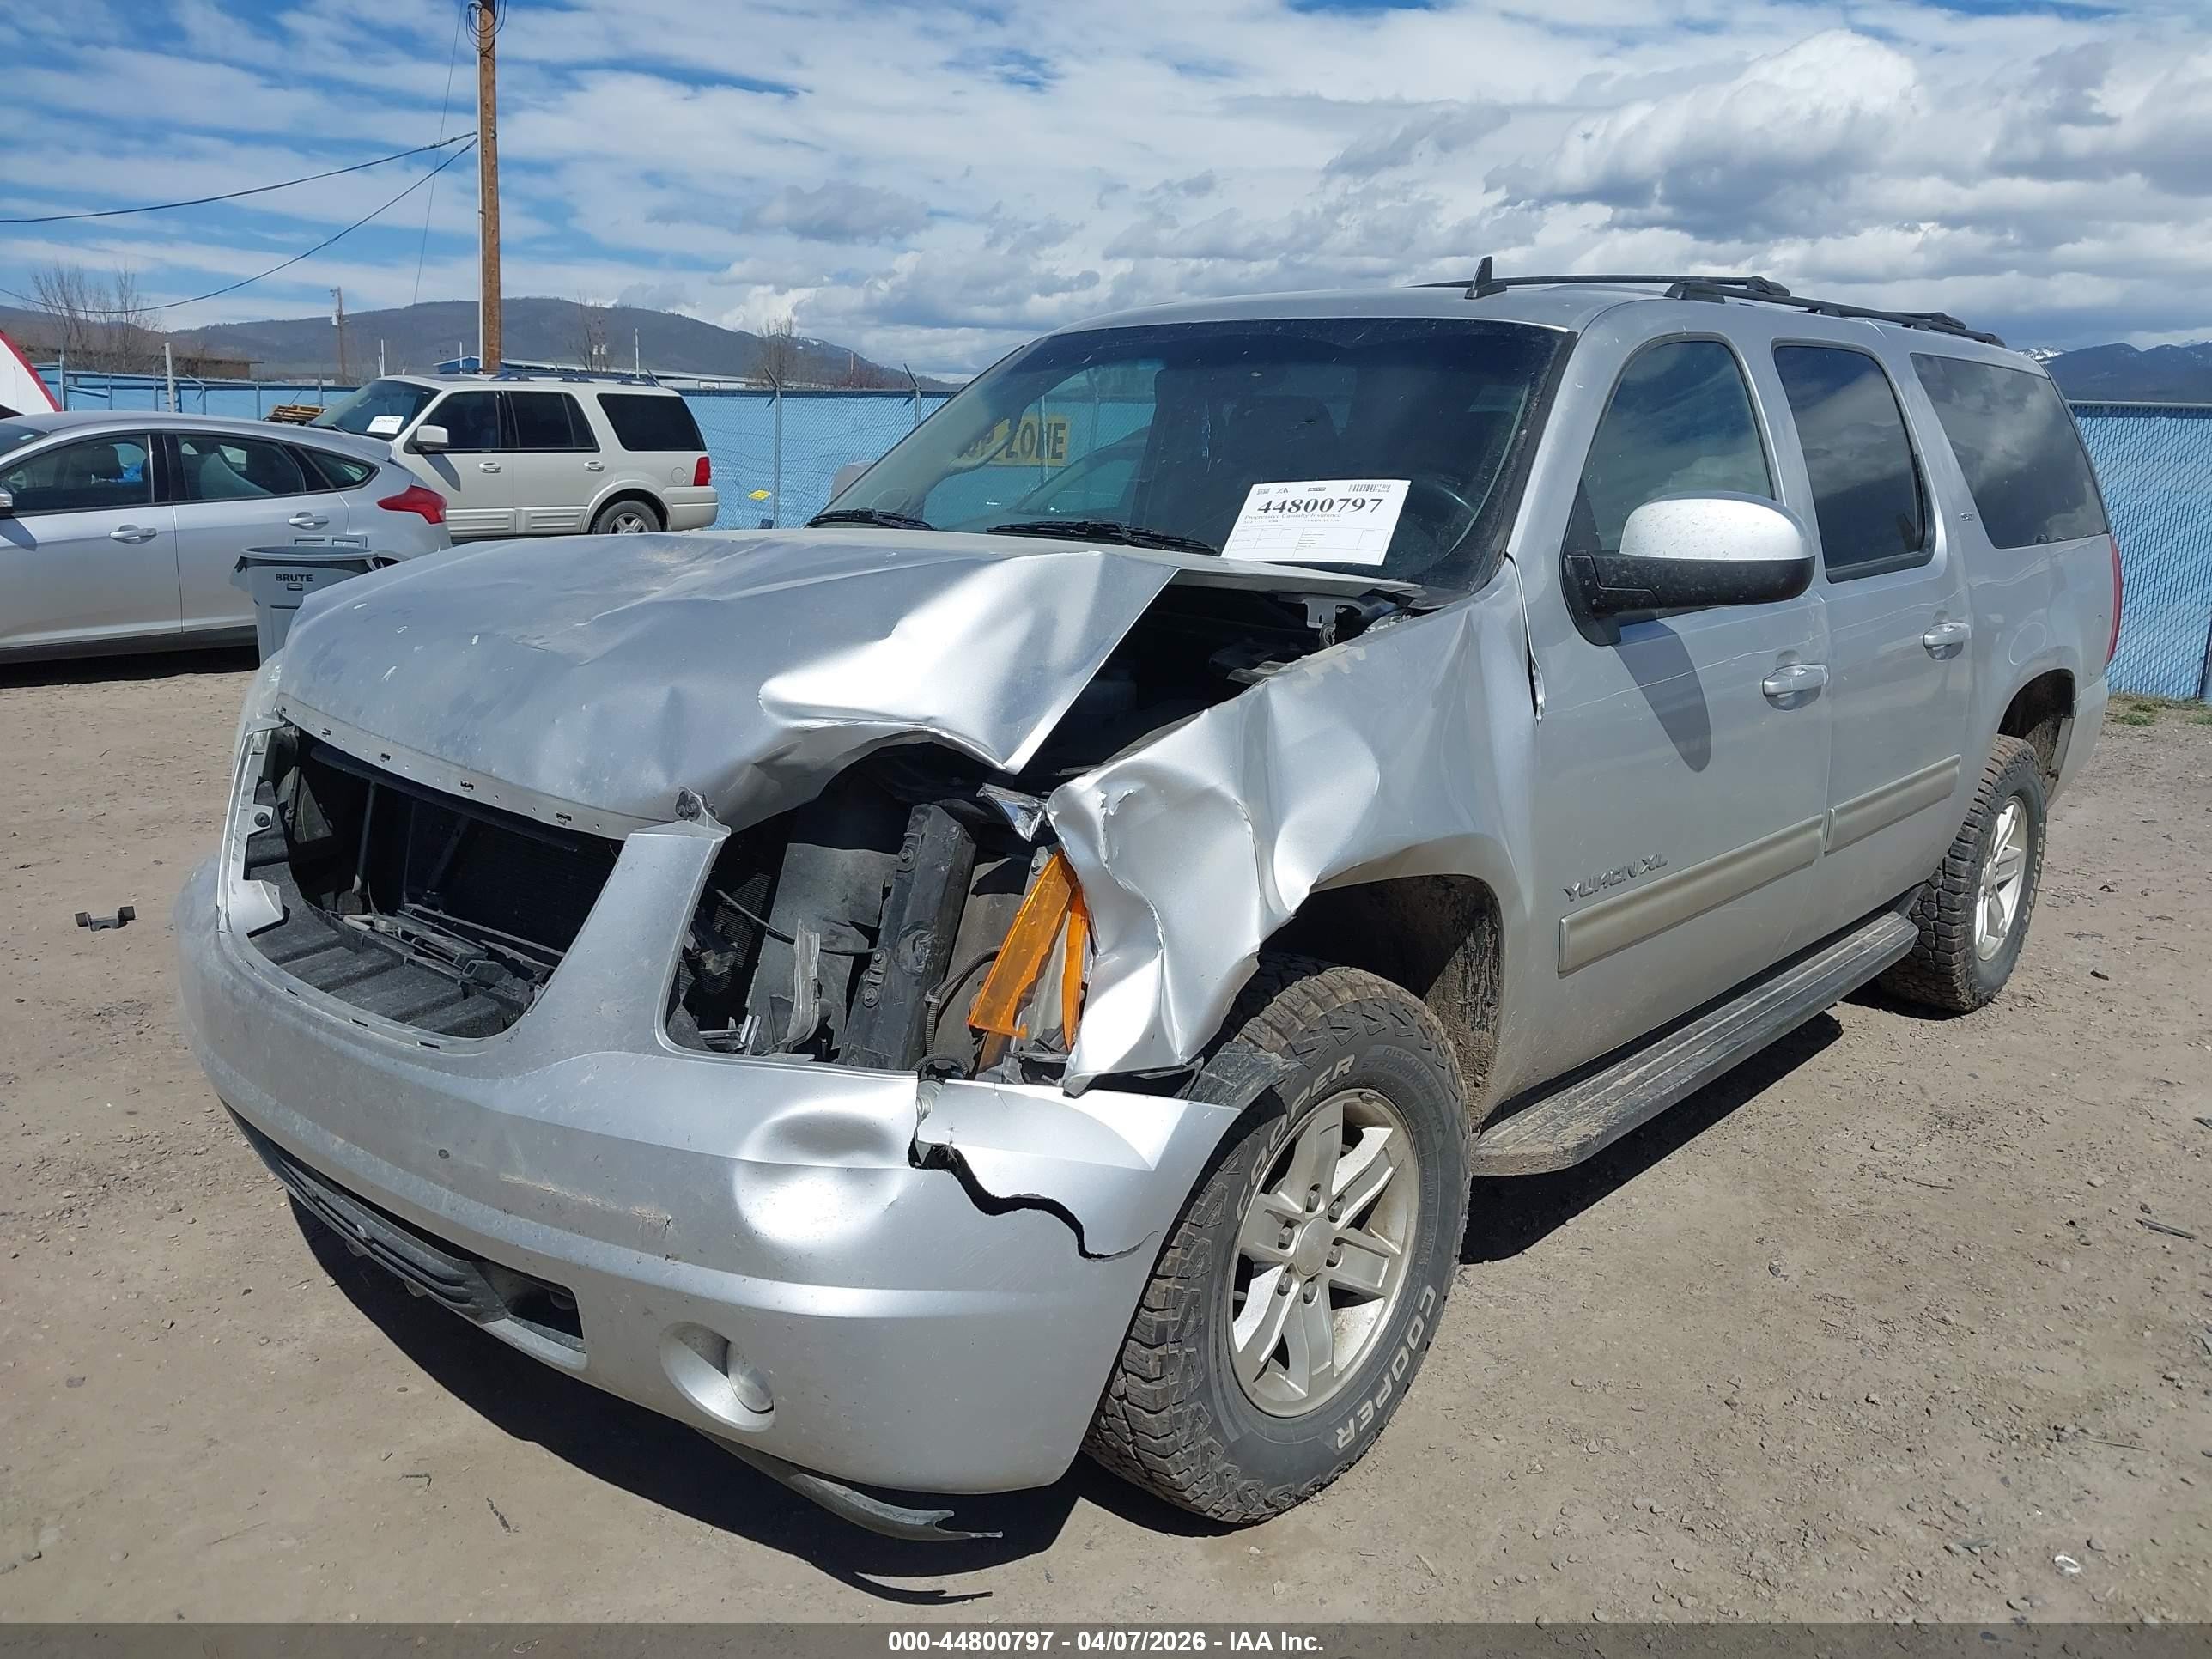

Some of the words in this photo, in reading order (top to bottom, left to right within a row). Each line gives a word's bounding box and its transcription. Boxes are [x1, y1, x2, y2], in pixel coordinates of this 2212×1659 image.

[1257, 497, 1384, 514] 44800797
[276, 574, 314, 582] BRUTE
[1563, 860, 1638, 902] YUKON
[1639, 853, 1669, 875] XL
[1237, 1054, 1356, 1222] COOPER
[1335, 1285, 1437, 1450] COOPER
